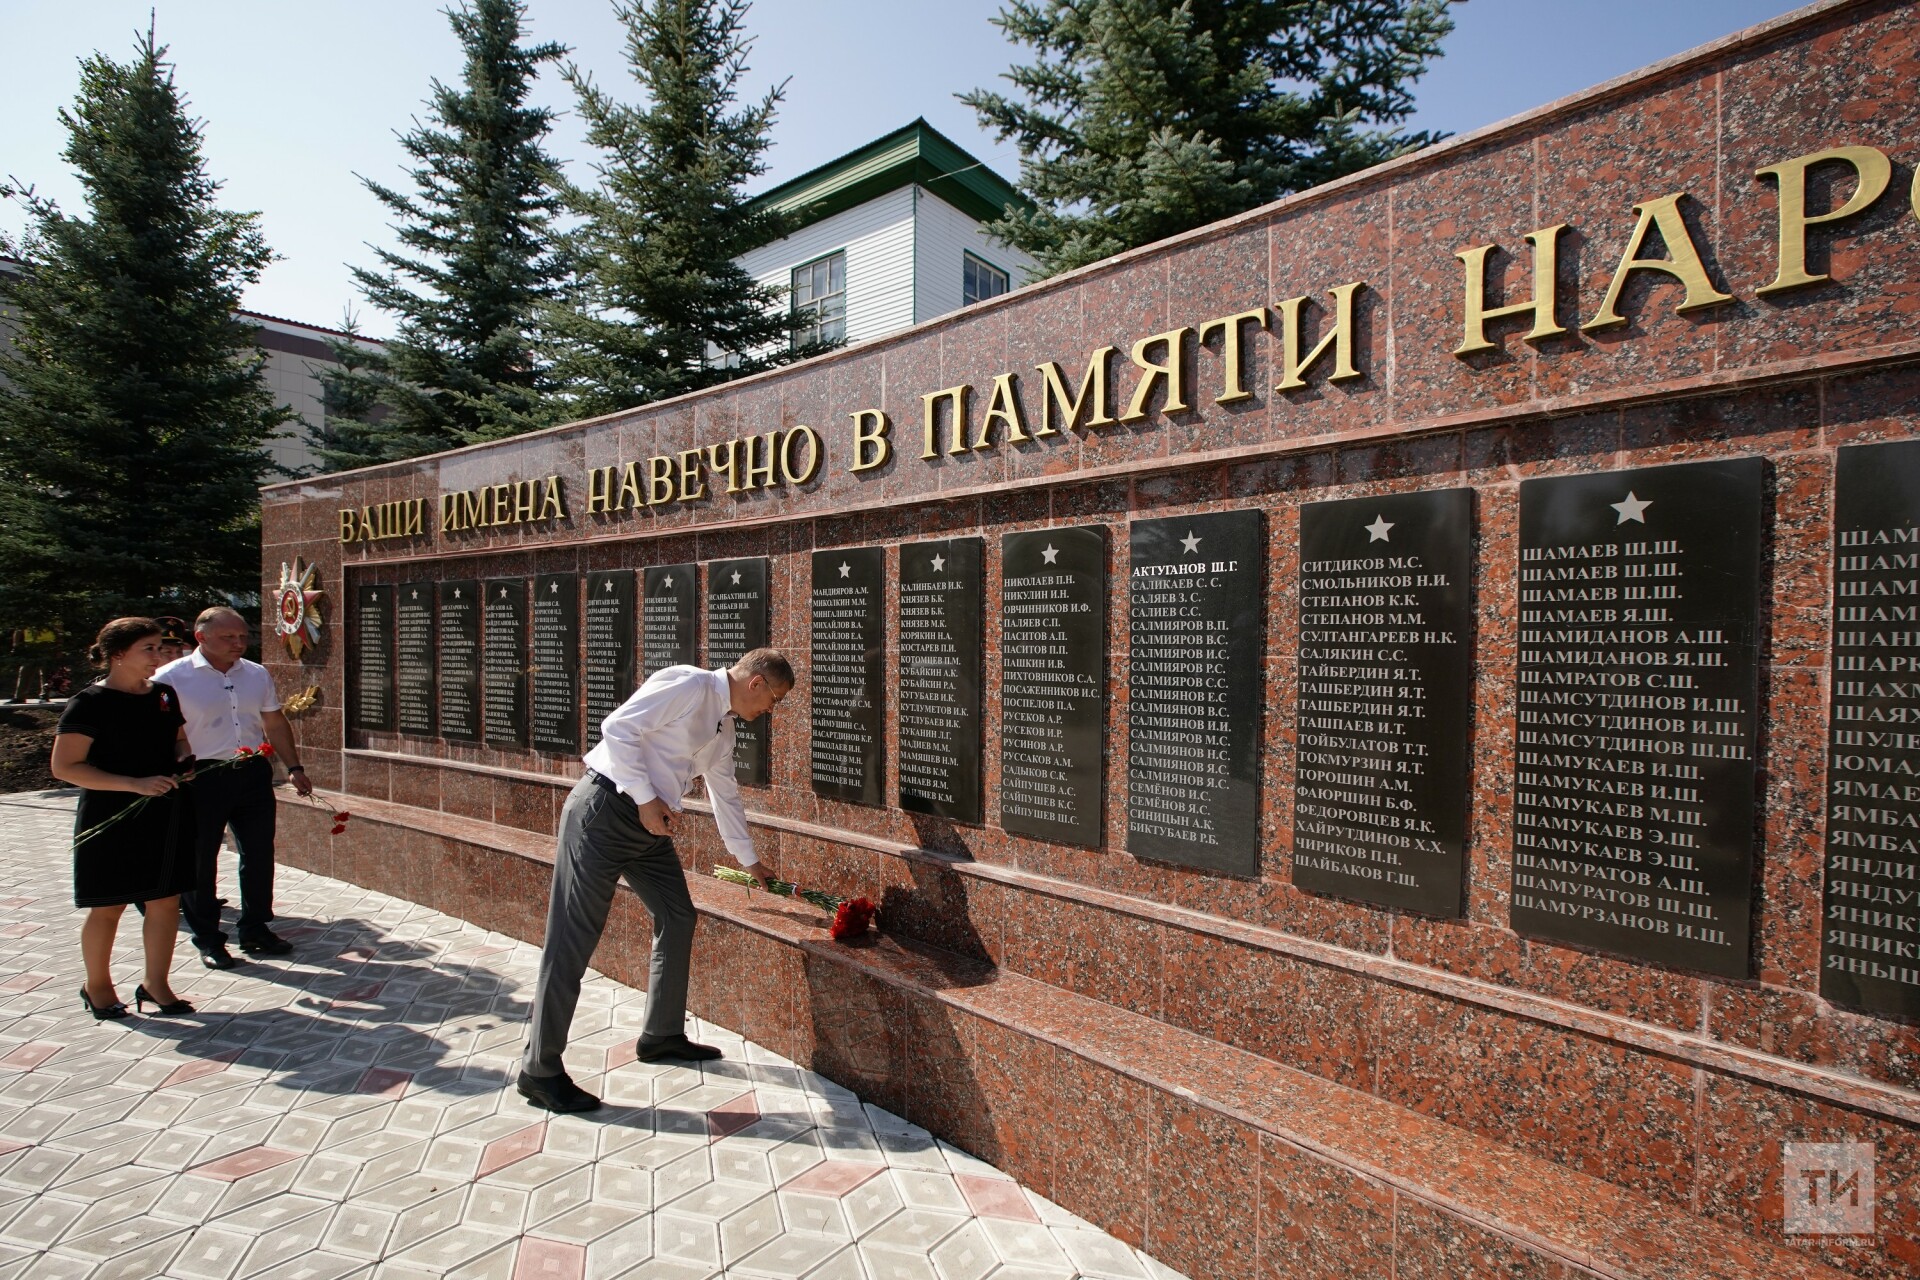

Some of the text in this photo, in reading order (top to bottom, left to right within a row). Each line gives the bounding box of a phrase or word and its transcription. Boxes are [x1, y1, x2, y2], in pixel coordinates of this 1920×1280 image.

[338, 145, 1920, 543] ВАШИ ИМЕНА НАВЕЧНО В ПАМЯТИ НАР
[1524, 540, 1683, 560] ШАМАЕВ Ш.Ш.
[1132, 562, 1206, 577] АКТУГАНОВ
[1302, 556, 1422, 573] СИТДИКОВ М.С.
[1524, 562, 1683, 581] ШАМАЕВ Ш.Ш.
[1004, 575, 1075, 587] НИКОЛАЕВ П.Н.
[1132, 578, 1193, 590] САЛИКАЕВ
[1302, 574, 1450, 589] СМОЛЬНИКОВ Н.И.
[1004, 589, 1069, 600] НИКУЛИН И.Н.
[1132, 593, 1176, 603] САЛЯЕВ
[1302, 594, 1419, 607] СТЕПАНОВ К.К.
[1523, 585, 1682, 601] ШАМАЕВ Ш.Ш.
[1004, 603, 1091, 613] ОВЧИННИКОВ И.Ф.
[1132, 606, 1201, 617] САЛИЕВ С.С.
[1523, 608, 1673, 622] ШАМАЕВ Я.Ш.
[1004, 618, 1060, 627] ПАЛЯЕВ С.П.
[1132, 620, 1228, 630] САЛМИЯРОВ В.П.
[1302, 613, 1425, 624] СТЕПАНОВ М.М.
[1004, 632, 1067, 640] ПАСИТОВ А.П.
[1132, 634, 1228, 645] САЛМИЯРОВ В.С.
[1301, 631, 1456, 643] СУЛТАНГАРЕЕВ Н.К.
[1522, 630, 1728, 645] ШАМИДАНОВ А.Ш.
[1004, 658, 1065, 668] ПАШКИН И.В.
[1301, 648, 1407, 661] САЛЯКИН С.С.
[1522, 650, 1728, 666] ШАМИДАНОВ Я.Ш.
[1131, 662, 1225, 673] САЛМИЯРОВ Р.С.
[1300, 664, 1421, 680] ТАЙБЕРДИН Я.Т.
[1004, 671, 1095, 683] ПИХТОВНИКОВ С.А.
[1131, 675, 1228, 688] САЛМИЯРОВ С.С.
[1521, 671, 1698, 689] ШАМРАТОВ С.Ш.
[1004, 684, 1099, 698] ПОСАЖЕННИКОВ И.С.
[1300, 682, 1426, 699] ТАШБЕРДИН Я.Т.
[1131, 702, 1229, 717] САЛМИЯНОВ В.С.
[1299, 699, 1425, 717] ТАШБЕРДИН Я.Т.
[1521, 691, 1745, 713] ШАМСУТДИНОВ И.Ш.
[1299, 716, 1406, 735] ТАШПАЕВ И.Т.
[1520, 711, 1744, 736] ШАМСУТДИНОВ И.Ш.
[1131, 742, 1230, 760] САЛМИЯНОВ Н.С.
[1298, 733, 1428, 756] ТОЙБУЛАТОВ Т.Т.
[1520, 731, 1751, 760] ШАМСУТДИНОВ Ш.Ш.
[1003, 751, 1073, 767] РУССАКОВ А.М.
[1130, 755, 1229, 774] САЛМИЯНОВ Я.С.
[1298, 751, 1424, 774] ТОКМУРЗИН Я.Т.
[1519, 752, 1704, 780] ШАМУКАЕВ И.Ш.
[1834, 754, 1920, 778] ЮМА
[1298, 768, 1412, 792] ТОРОШИН А.М.
[1519, 772, 1703, 802] ШАМУКАЕВ И.Ш.
[1130, 782, 1211, 801] СЕМЁНОВ И.С.
[1297, 786, 1416, 811] ФАЮРШИН Б.Ф.
[1130, 795, 1210, 815] СЕМЁНОВ Я.С.
[1518, 792, 1707, 826] ШАМУКАЕВ М.Ш.
[1130, 809, 1214, 830] СИНИЦЫН А.К.
[1297, 803, 1435, 833] ФЕДОРОВЦЕВ Я.К.
[1130, 822, 1218, 845] БИКТУБАЕВ Р.Б.
[1296, 820, 1445, 854] ХАЙРУТДИНОВ Х.Х.
[1518, 813, 1700, 848] ШАМУКАЕВ Э.Ш.
[1296, 837, 1401, 865] ЧИРИКОВ П.Н.
[1517, 833, 1699, 871] ШАМУКАЕВ Э.Ш.
[1295, 854, 1419, 887] ШАЙБАКОВ Г.Ш.
[1517, 854, 1709, 895] ШАМУРАТОВ А.Ш.
[1516, 874, 1718, 920] ШАМУРАТОВ Ш.Ш.
[1515, 894, 1730, 945] ШАМУРЗАНОВ И.Ш.
